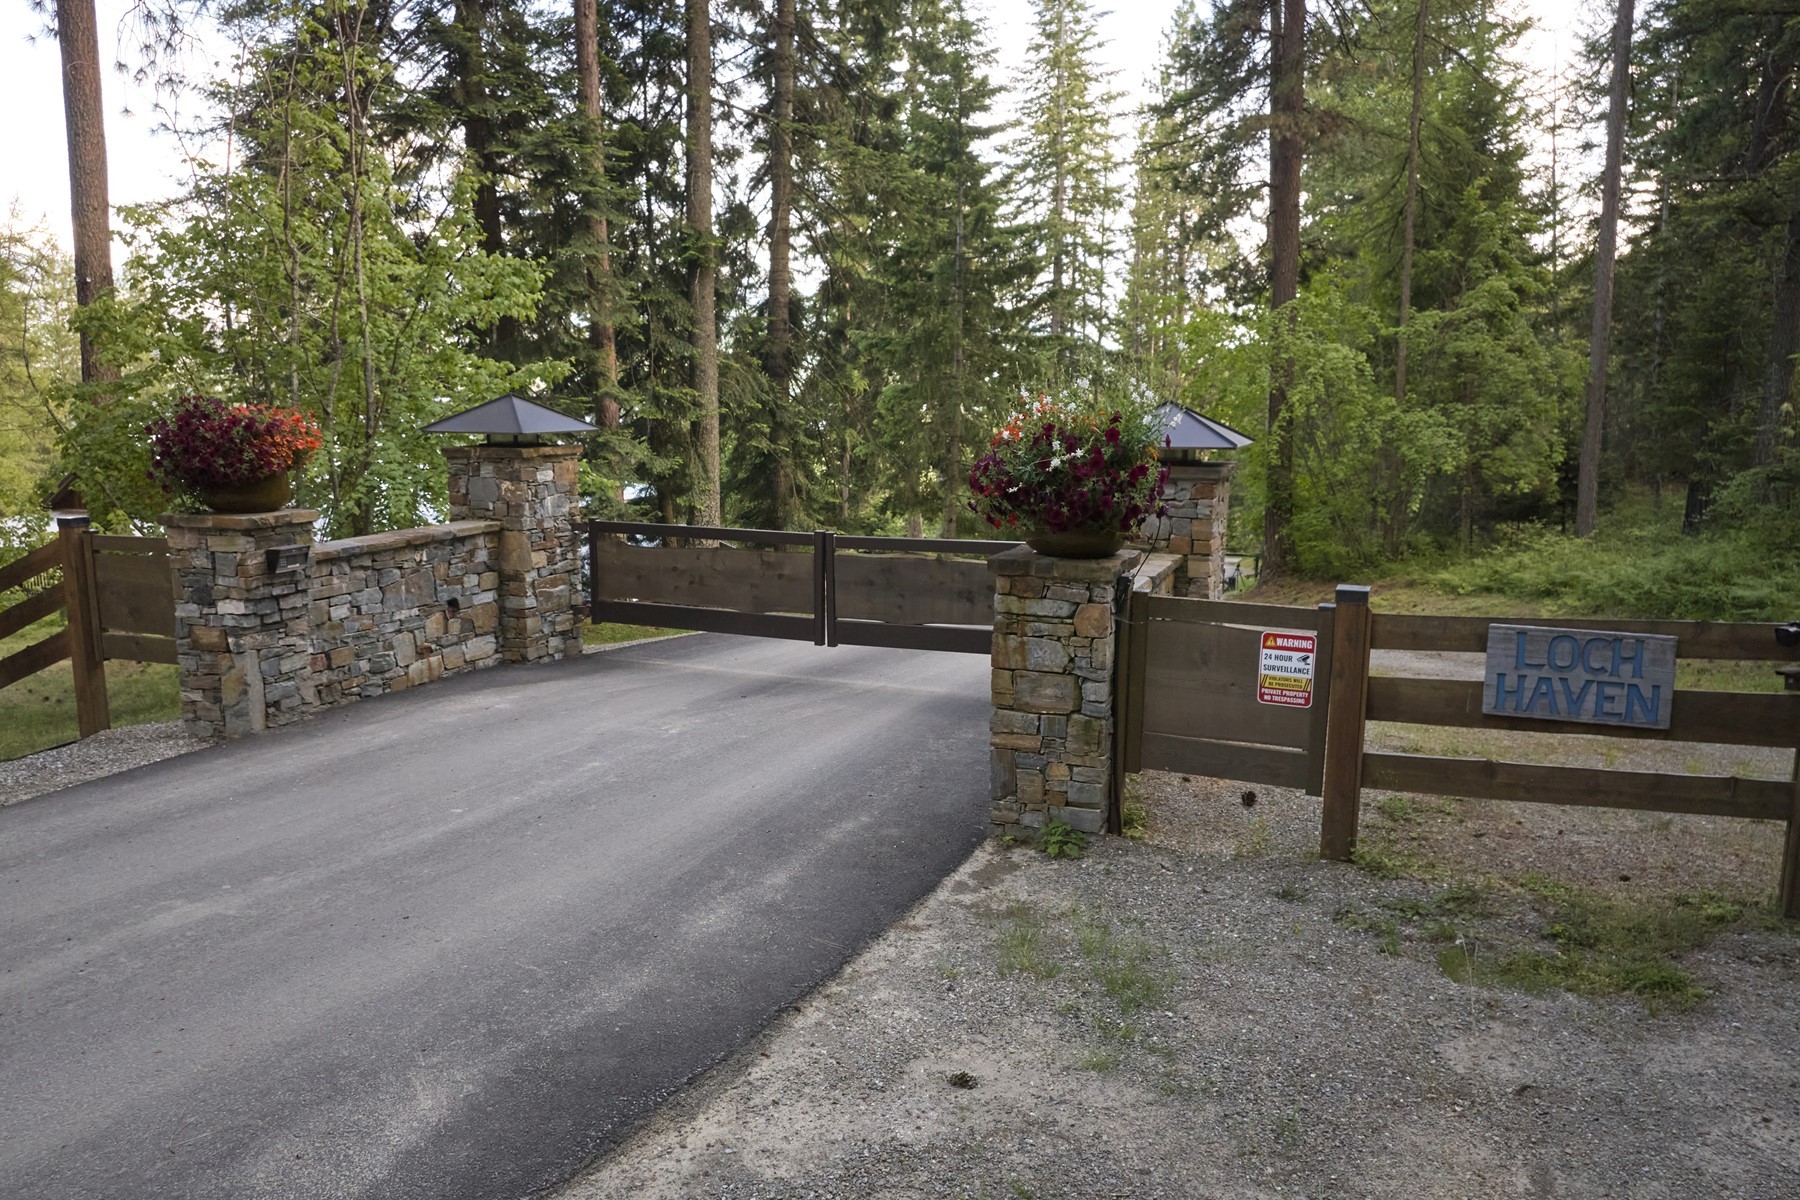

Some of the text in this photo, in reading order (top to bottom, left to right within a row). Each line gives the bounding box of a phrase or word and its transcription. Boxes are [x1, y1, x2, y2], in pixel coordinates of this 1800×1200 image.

[1276, 638, 1312, 649] WARNING
[1514, 632, 1645, 679] LOCH
[1263, 664, 1310, 674] SURVEILLANCE
[1272, 696, 1305, 704] TRESPASSING
[1493, 673, 1661, 722] HAVEN
